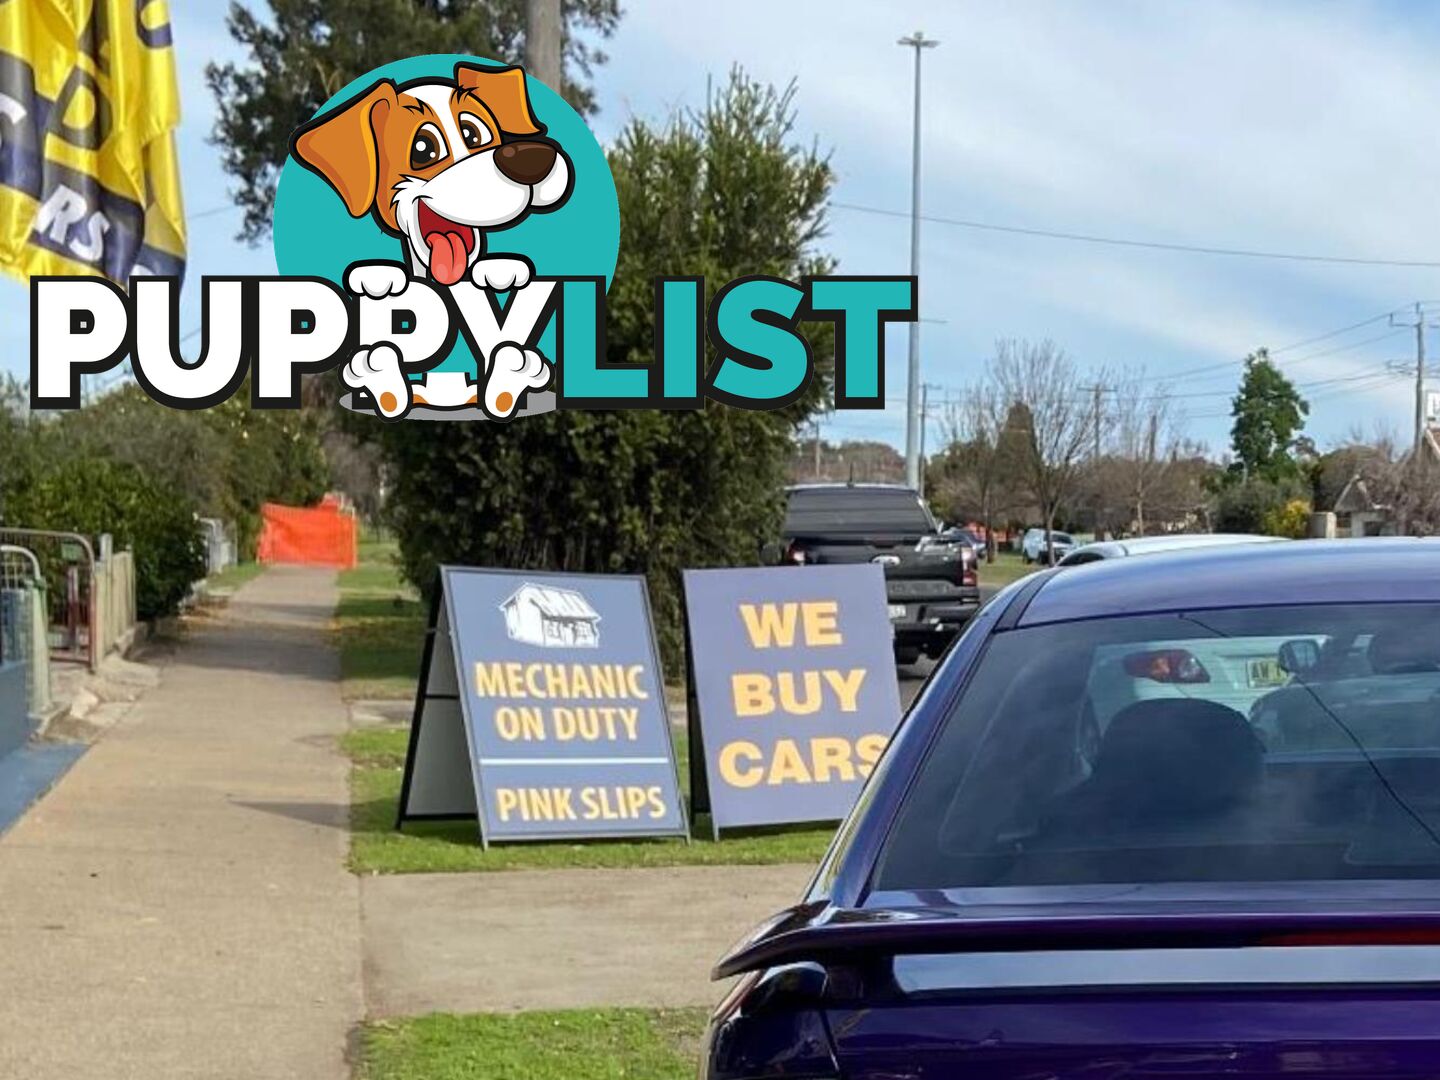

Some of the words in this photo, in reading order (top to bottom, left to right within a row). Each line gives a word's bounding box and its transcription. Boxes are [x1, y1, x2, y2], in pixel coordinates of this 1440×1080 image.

[739, 602, 842, 648] WE
[474, 661, 649, 699] MECHANIC
[732, 669, 866, 717] BUY
[495, 706, 546, 741] ON
[552, 706, 638, 741] DUTY
[719, 733, 889, 788] CARS
[496, 787, 577, 822] PINK
[580, 785, 667, 820] SLIPS
